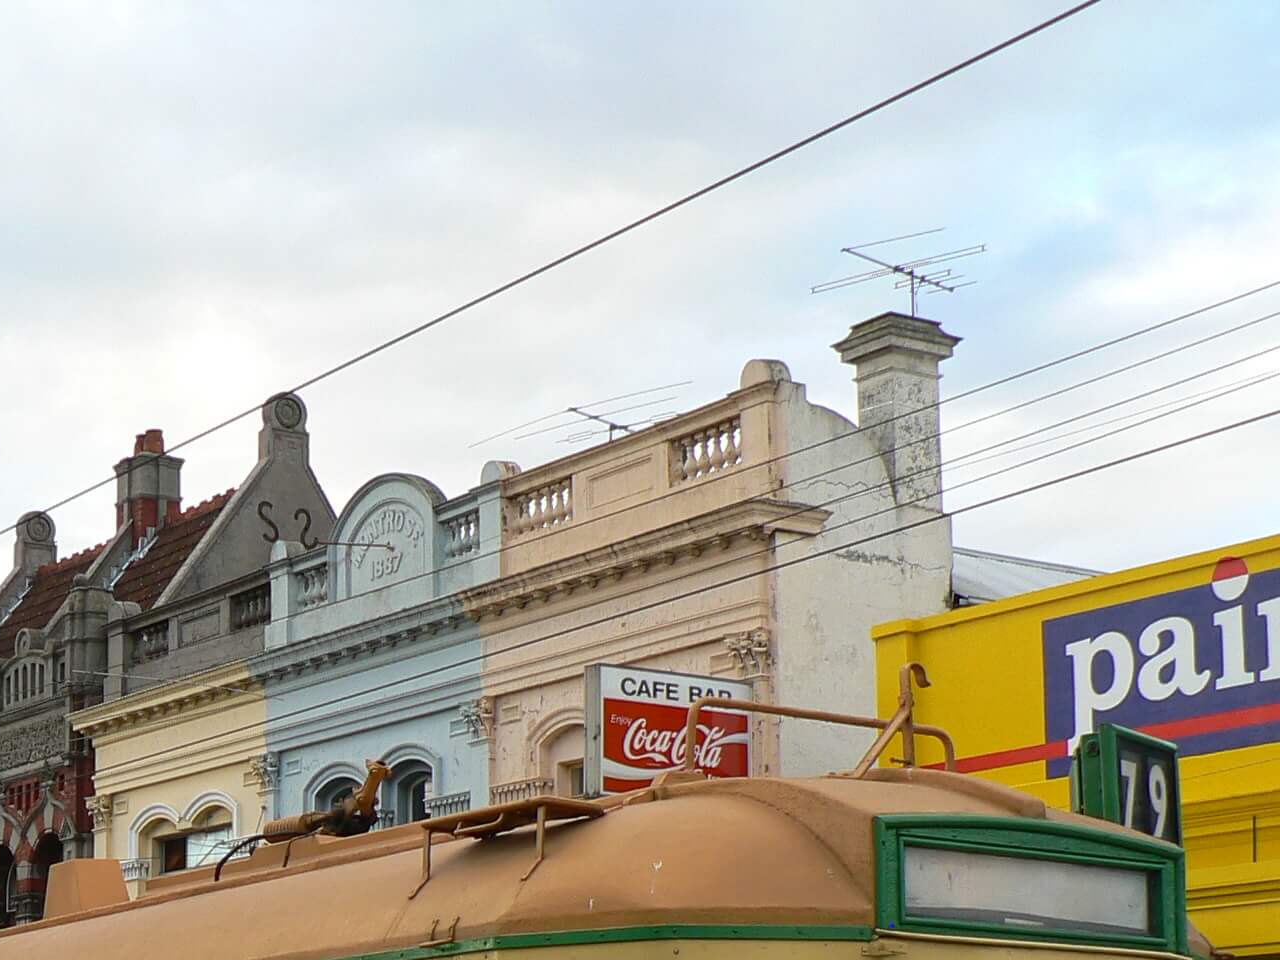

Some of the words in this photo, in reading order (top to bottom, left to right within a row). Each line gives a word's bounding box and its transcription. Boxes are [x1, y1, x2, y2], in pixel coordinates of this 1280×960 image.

[370, 552, 404, 582] 1887
[1065, 556, 1280, 757] pai
[620, 677, 680, 701] CAFE
[609, 714, 632, 726] Enjoy
[622, 717, 725, 769] Coca-Cola
[1120, 759, 1168, 840] 79
